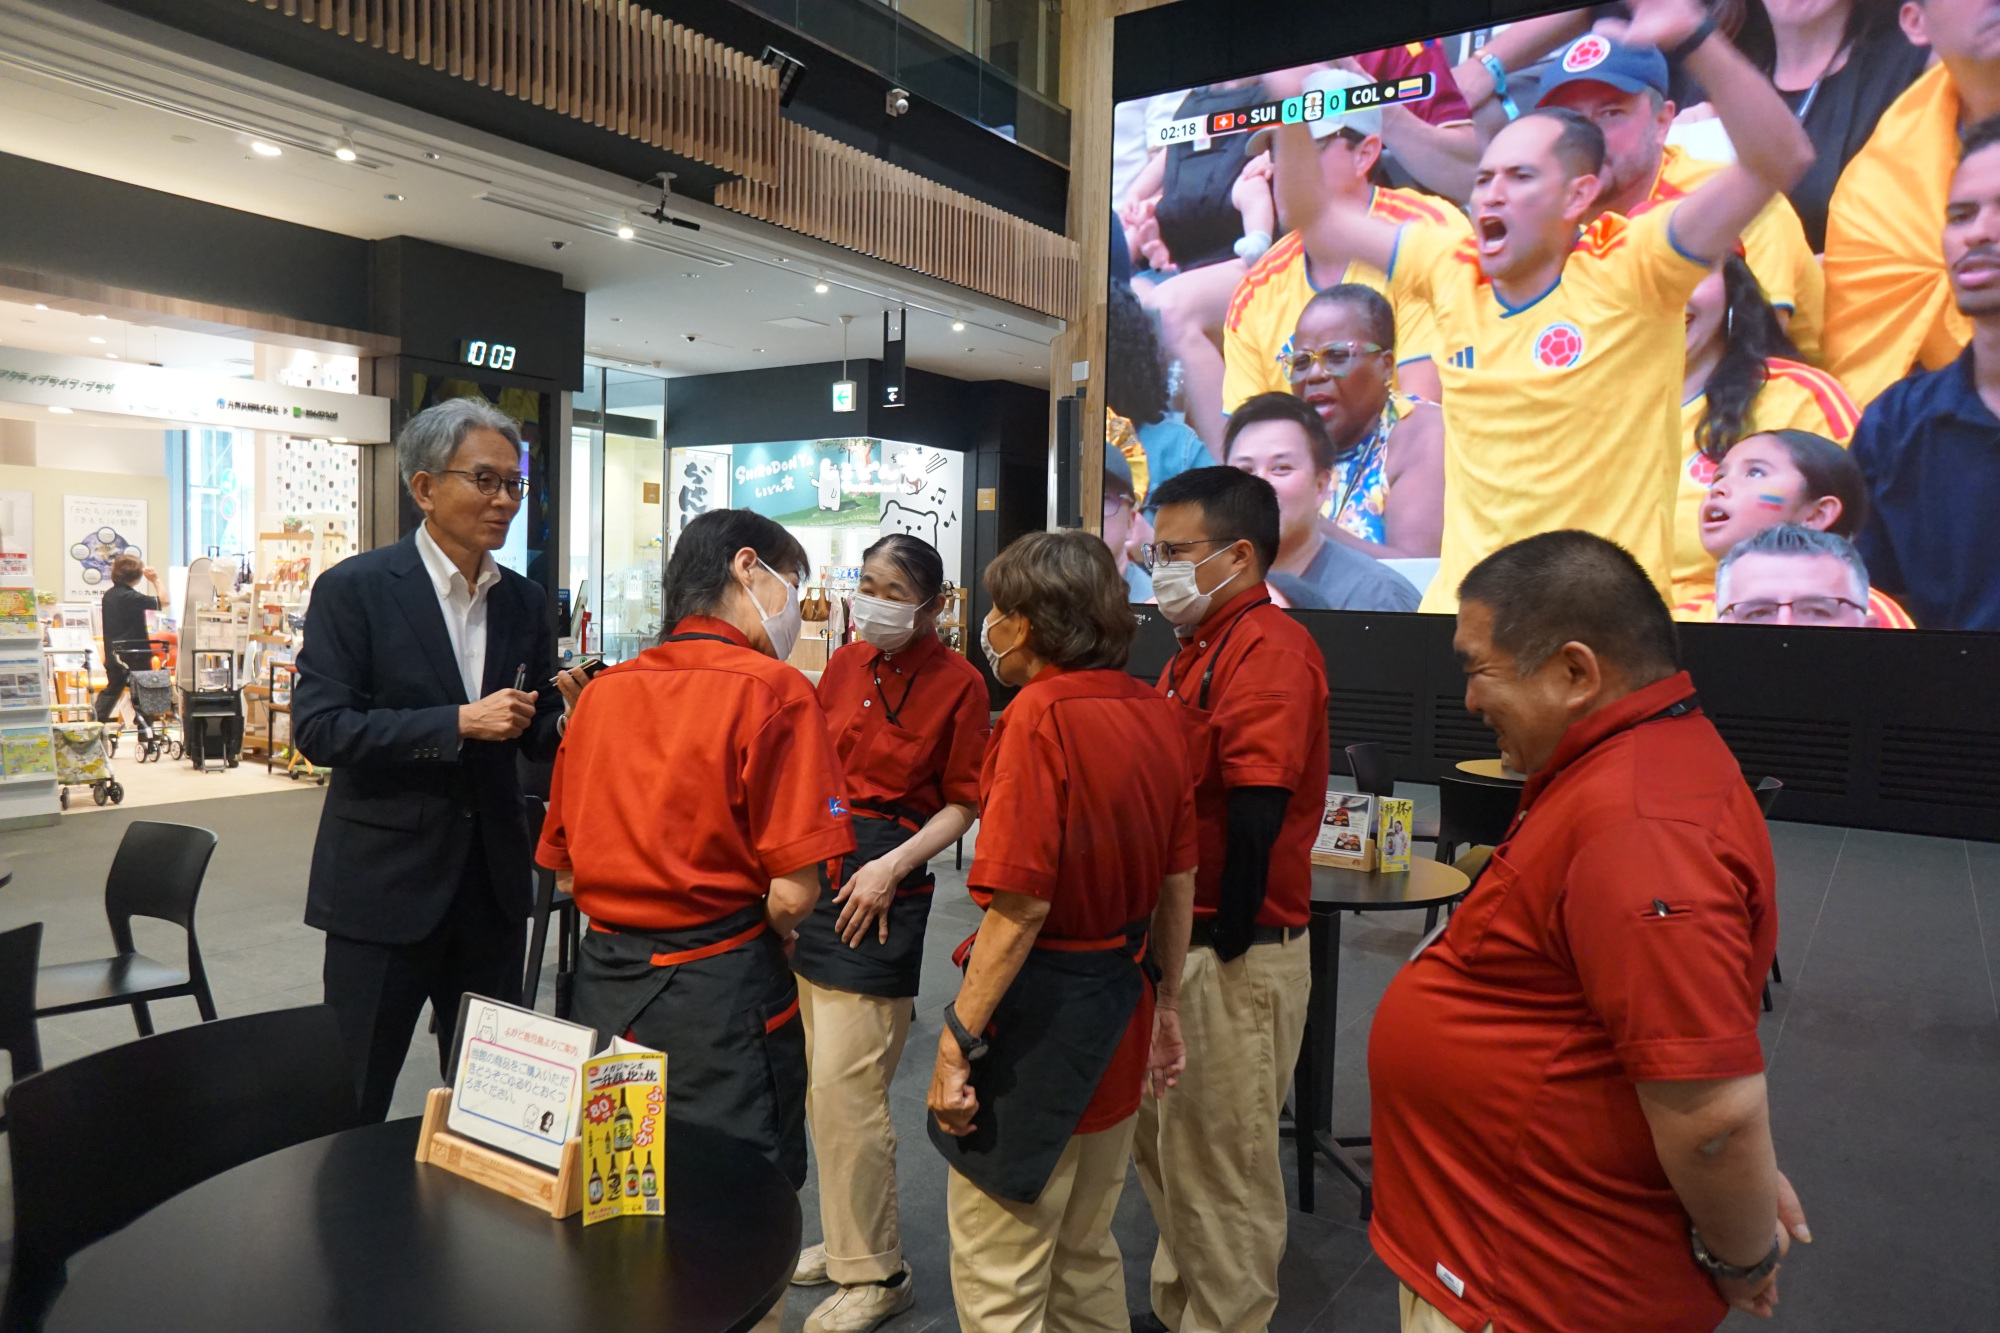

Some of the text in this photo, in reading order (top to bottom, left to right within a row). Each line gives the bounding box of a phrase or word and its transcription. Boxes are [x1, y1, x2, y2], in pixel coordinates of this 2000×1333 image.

[1160, 122, 1196, 140] 02:18
[1250, 106, 1276, 123] SUI
[1288, 102, 1297, 117] 0
[1331, 95, 1340, 110] 0
[1352, 87, 1380, 105] COL
